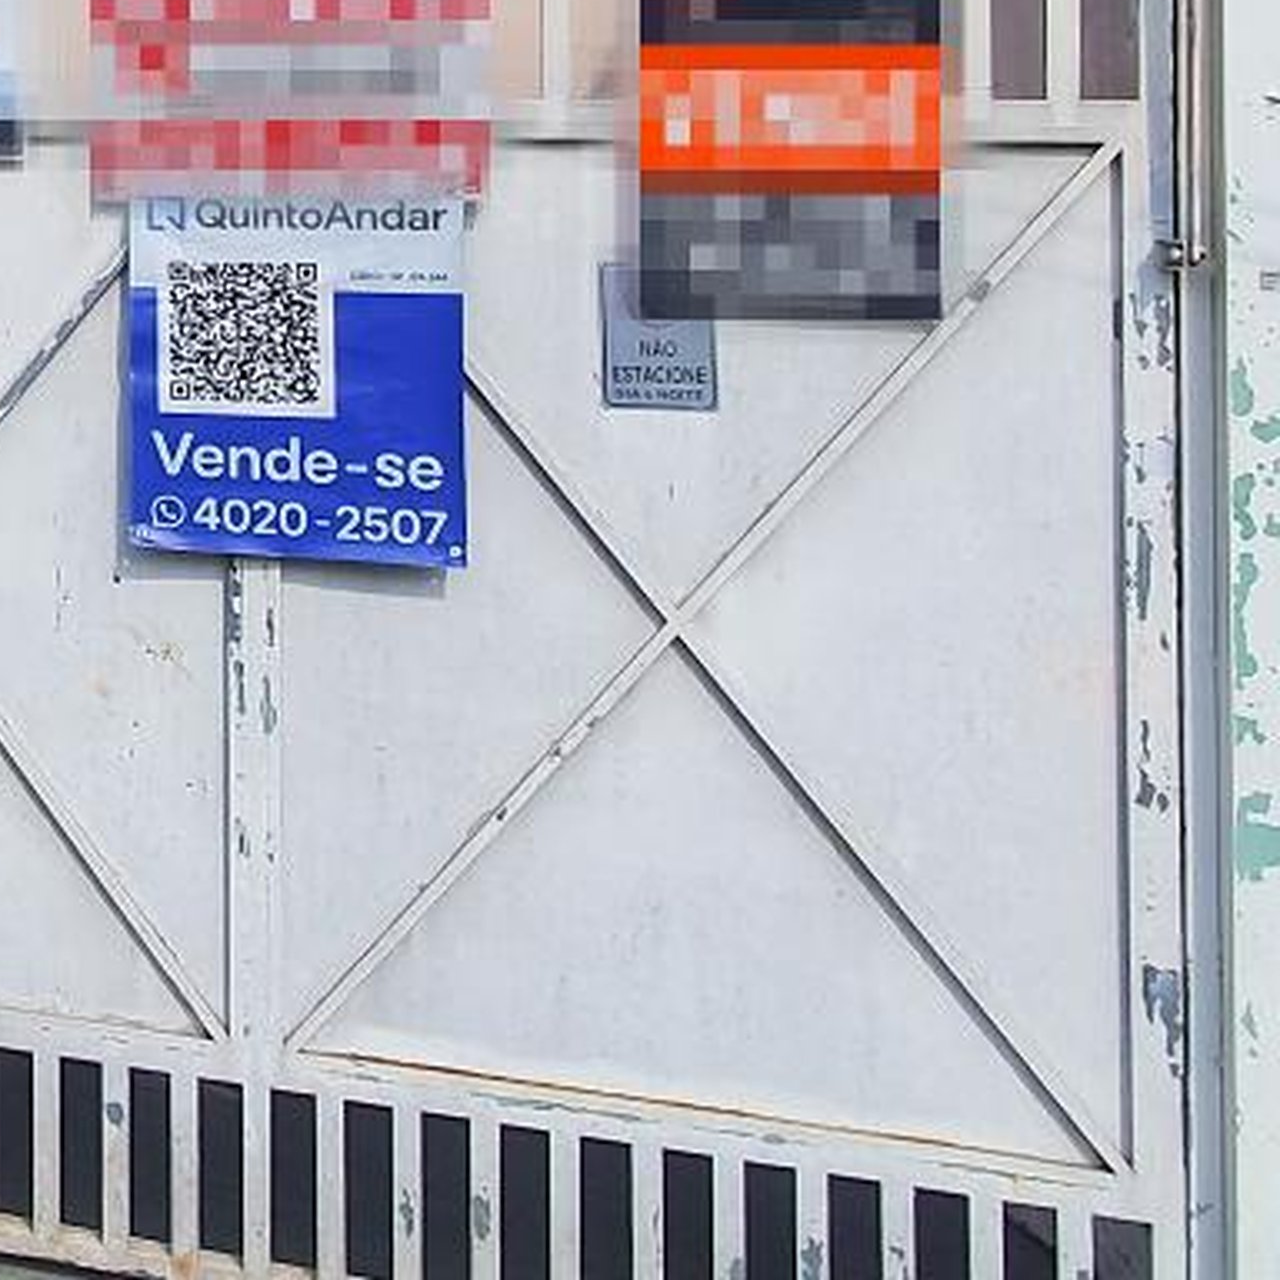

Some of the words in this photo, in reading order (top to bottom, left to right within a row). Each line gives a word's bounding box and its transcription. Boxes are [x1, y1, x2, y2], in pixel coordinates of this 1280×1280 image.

[195, 200, 448, 231] QuintoAndar
[613, 365, 708, 384] ESTACIONE
[151, 429, 443, 491] Vende-se
[193, 497, 448, 544] 4020-2507
